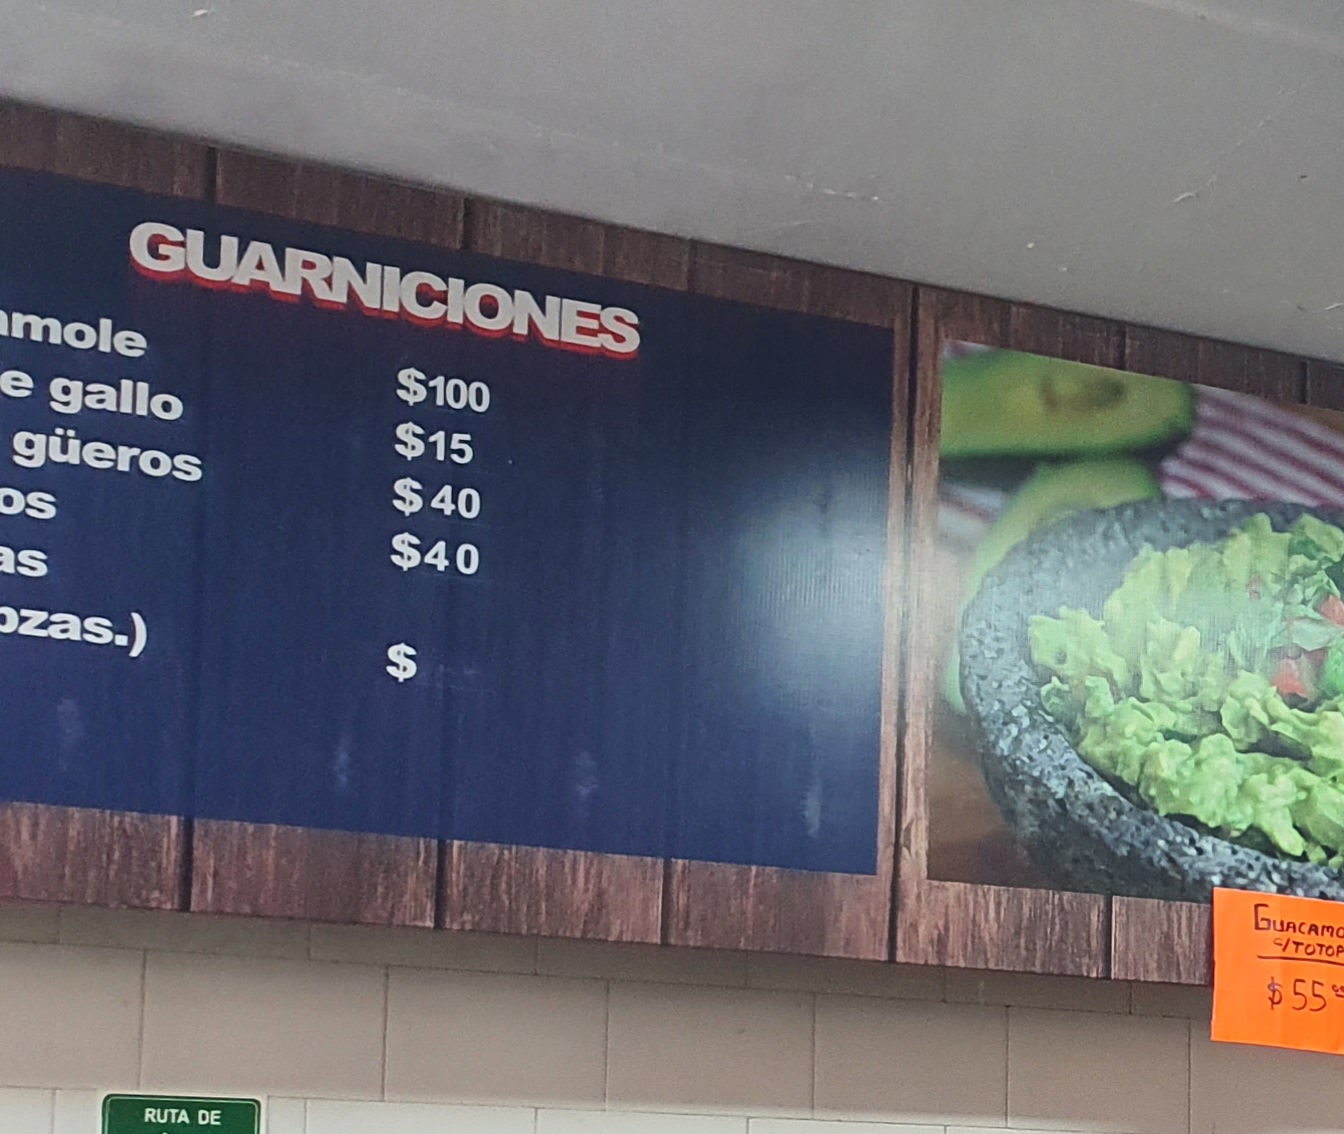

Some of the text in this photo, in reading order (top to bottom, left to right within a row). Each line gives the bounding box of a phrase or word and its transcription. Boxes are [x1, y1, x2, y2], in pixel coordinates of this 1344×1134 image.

[129, 221, 640, 357] GUARNICIONES
[0, 309, 491, 413] mole $100
[13, 427, 203, 482] güeros
[49, 377, 184, 421] gallo
[394, 421, 474, 464] $15
[144, 1107, 222, 1126] RUTA DE
